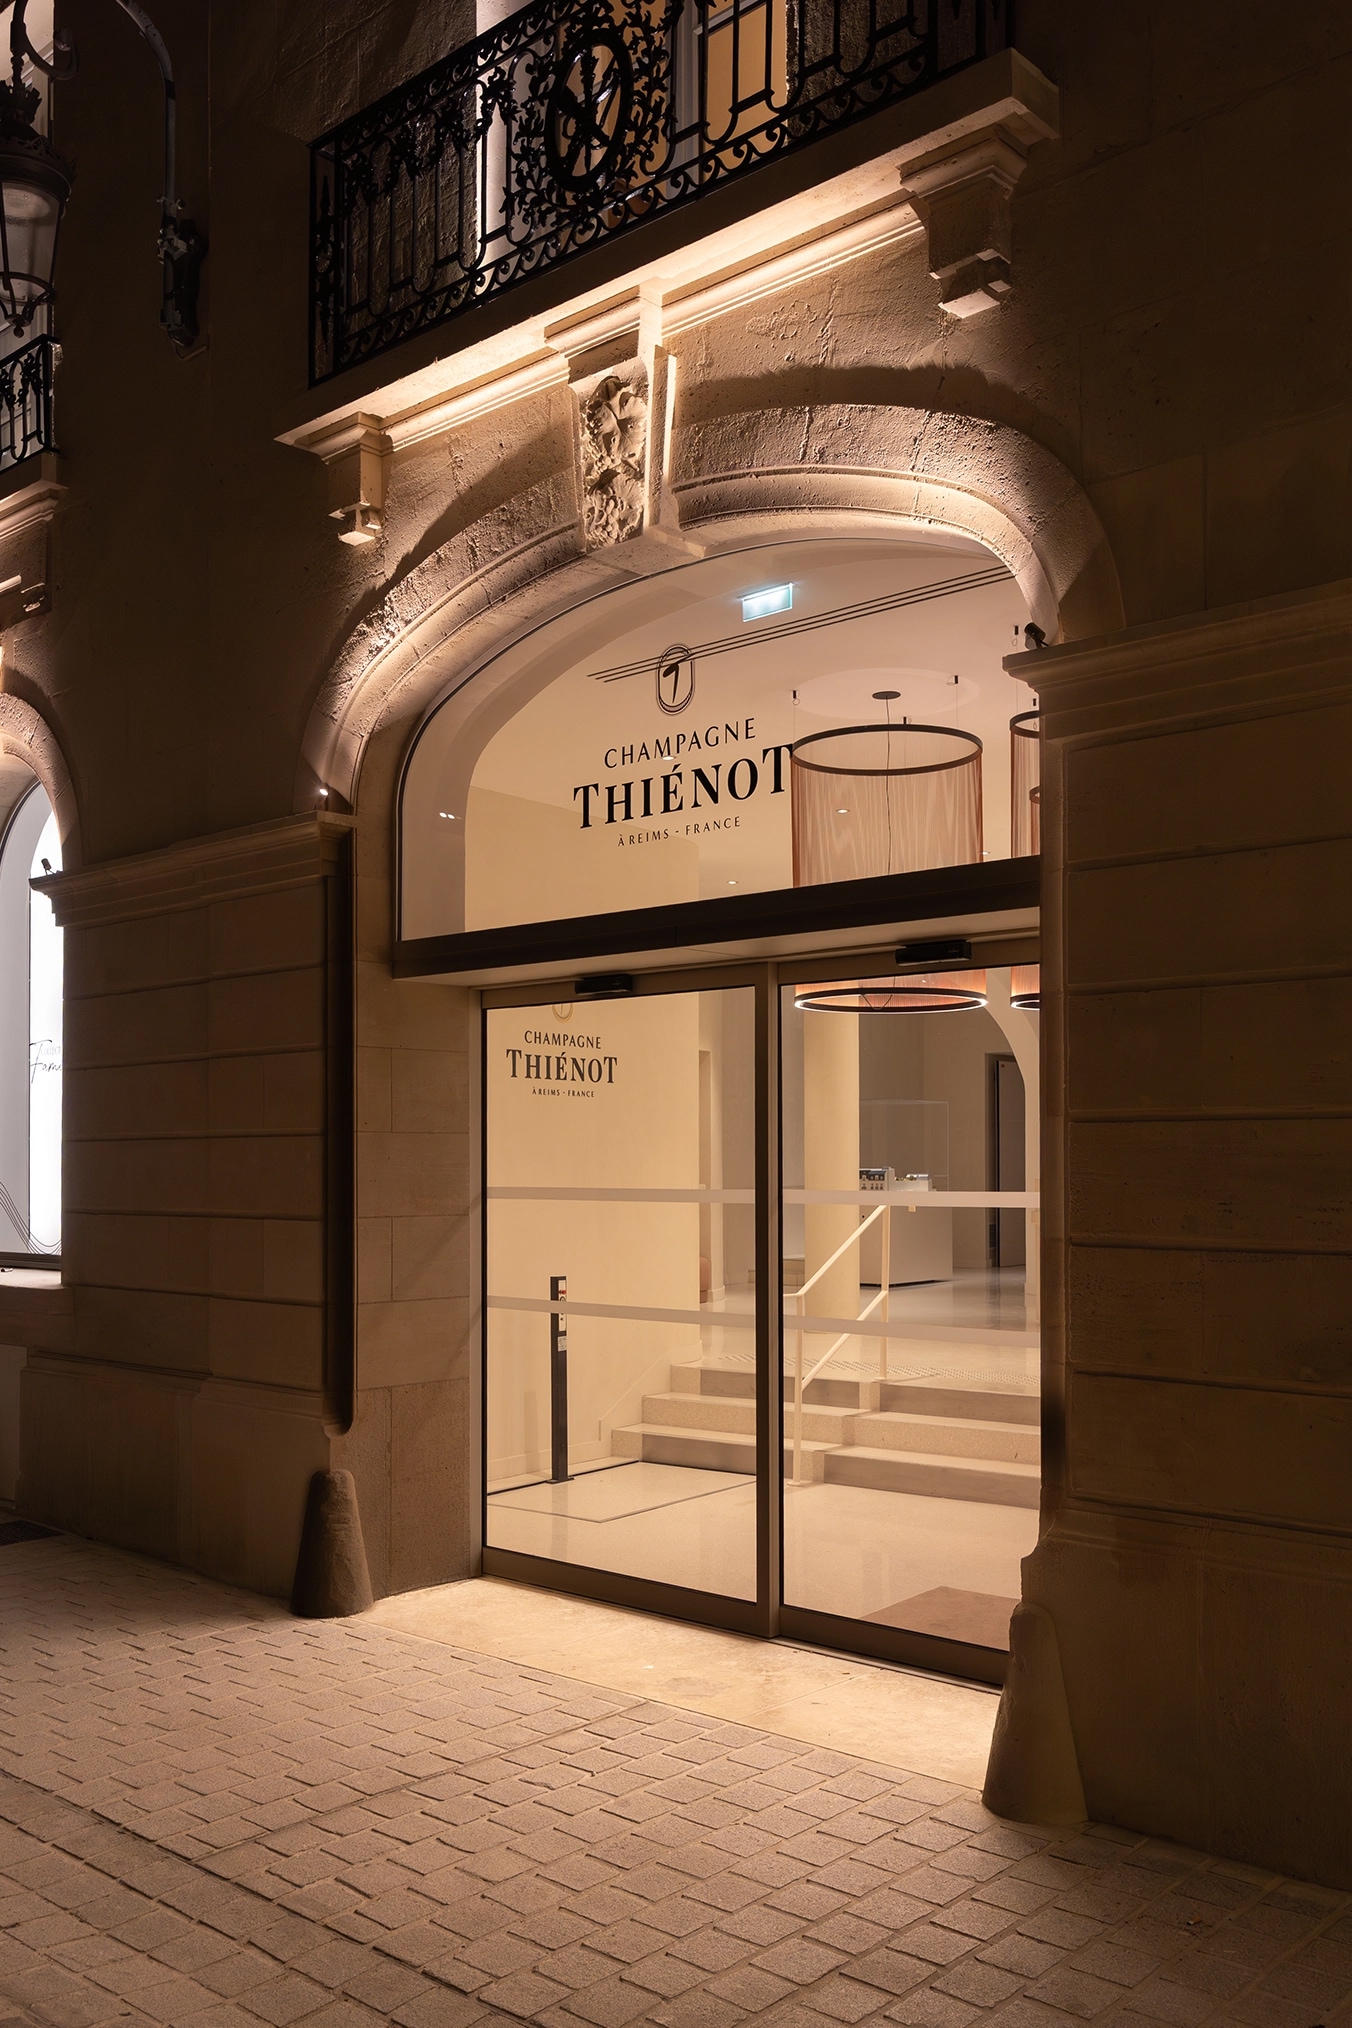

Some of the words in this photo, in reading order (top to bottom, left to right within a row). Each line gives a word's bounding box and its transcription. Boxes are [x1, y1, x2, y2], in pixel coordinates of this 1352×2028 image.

[604, 718, 756, 768] CHAMPAGNE
[573, 743, 794, 829] THIÉNOT
[686, 816, 741, 836] FRANCE
[524, 1030, 602, 1049] CHAMPAGNE
[506, 1048, 618, 1084] THIÉNOT
[568, 1089, 594, 1098] FRANCE
